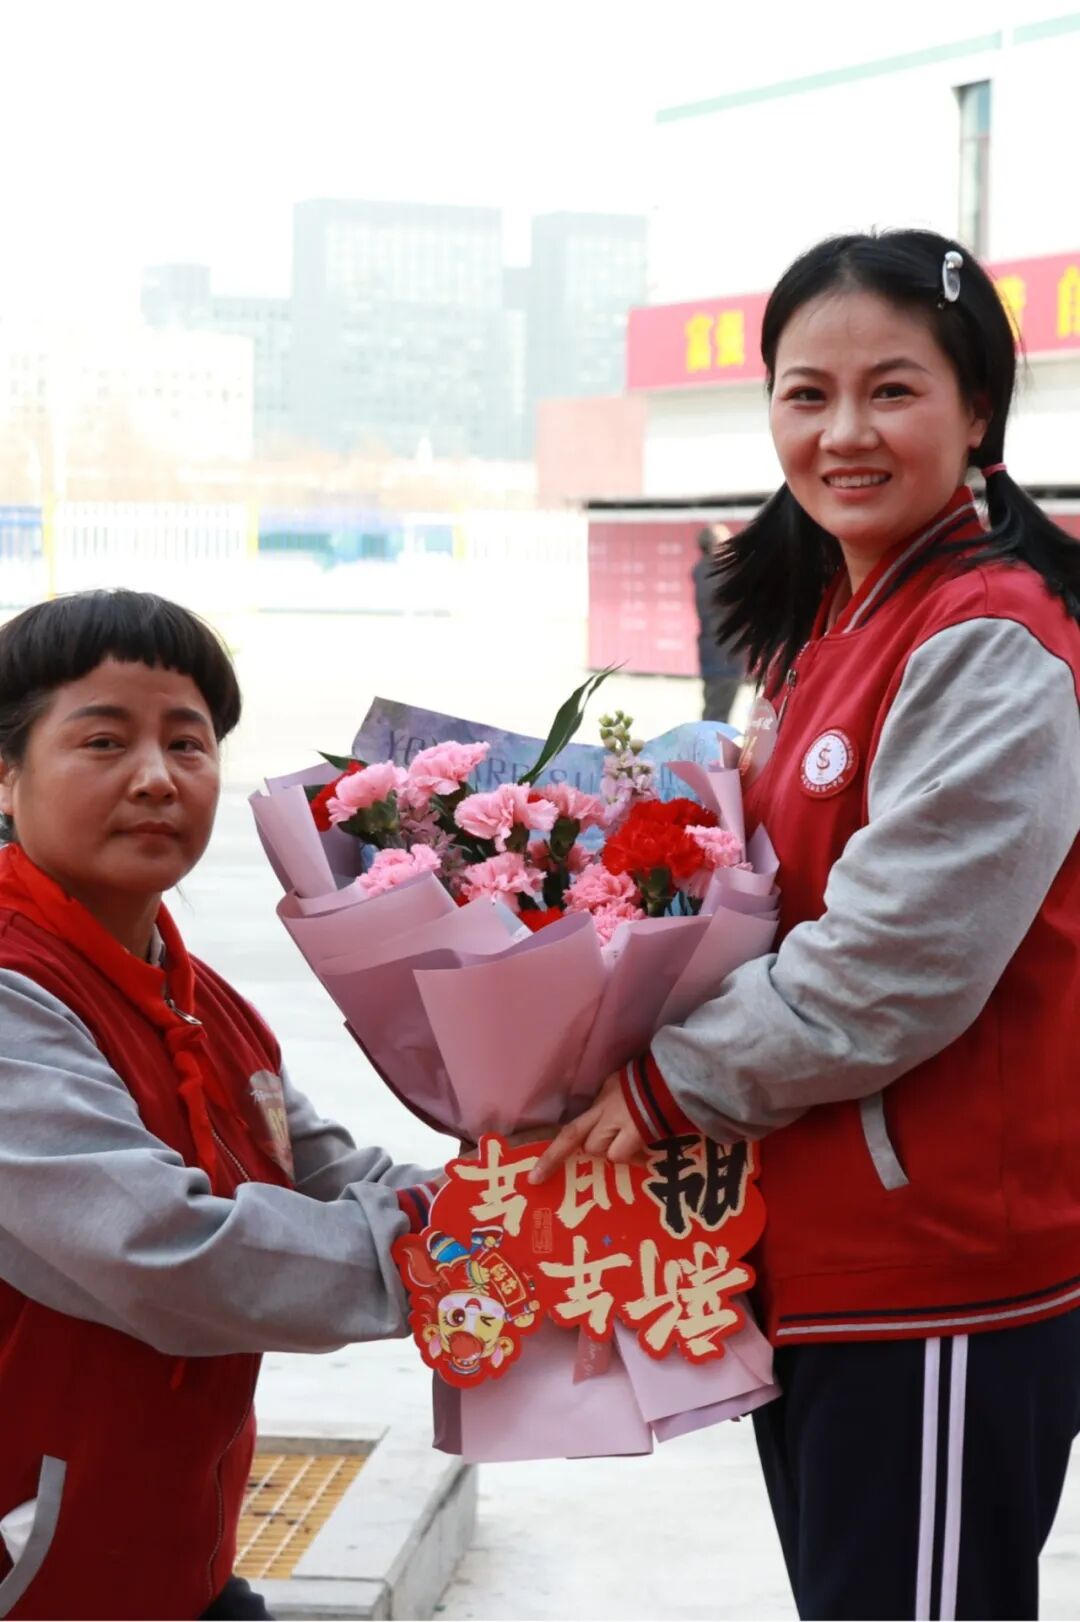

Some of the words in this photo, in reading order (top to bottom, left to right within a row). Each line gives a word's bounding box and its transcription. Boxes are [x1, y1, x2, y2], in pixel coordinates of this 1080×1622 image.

[453, 1136, 749, 1237] 胜旧年
[538, 1235, 750, 1357] 新年
